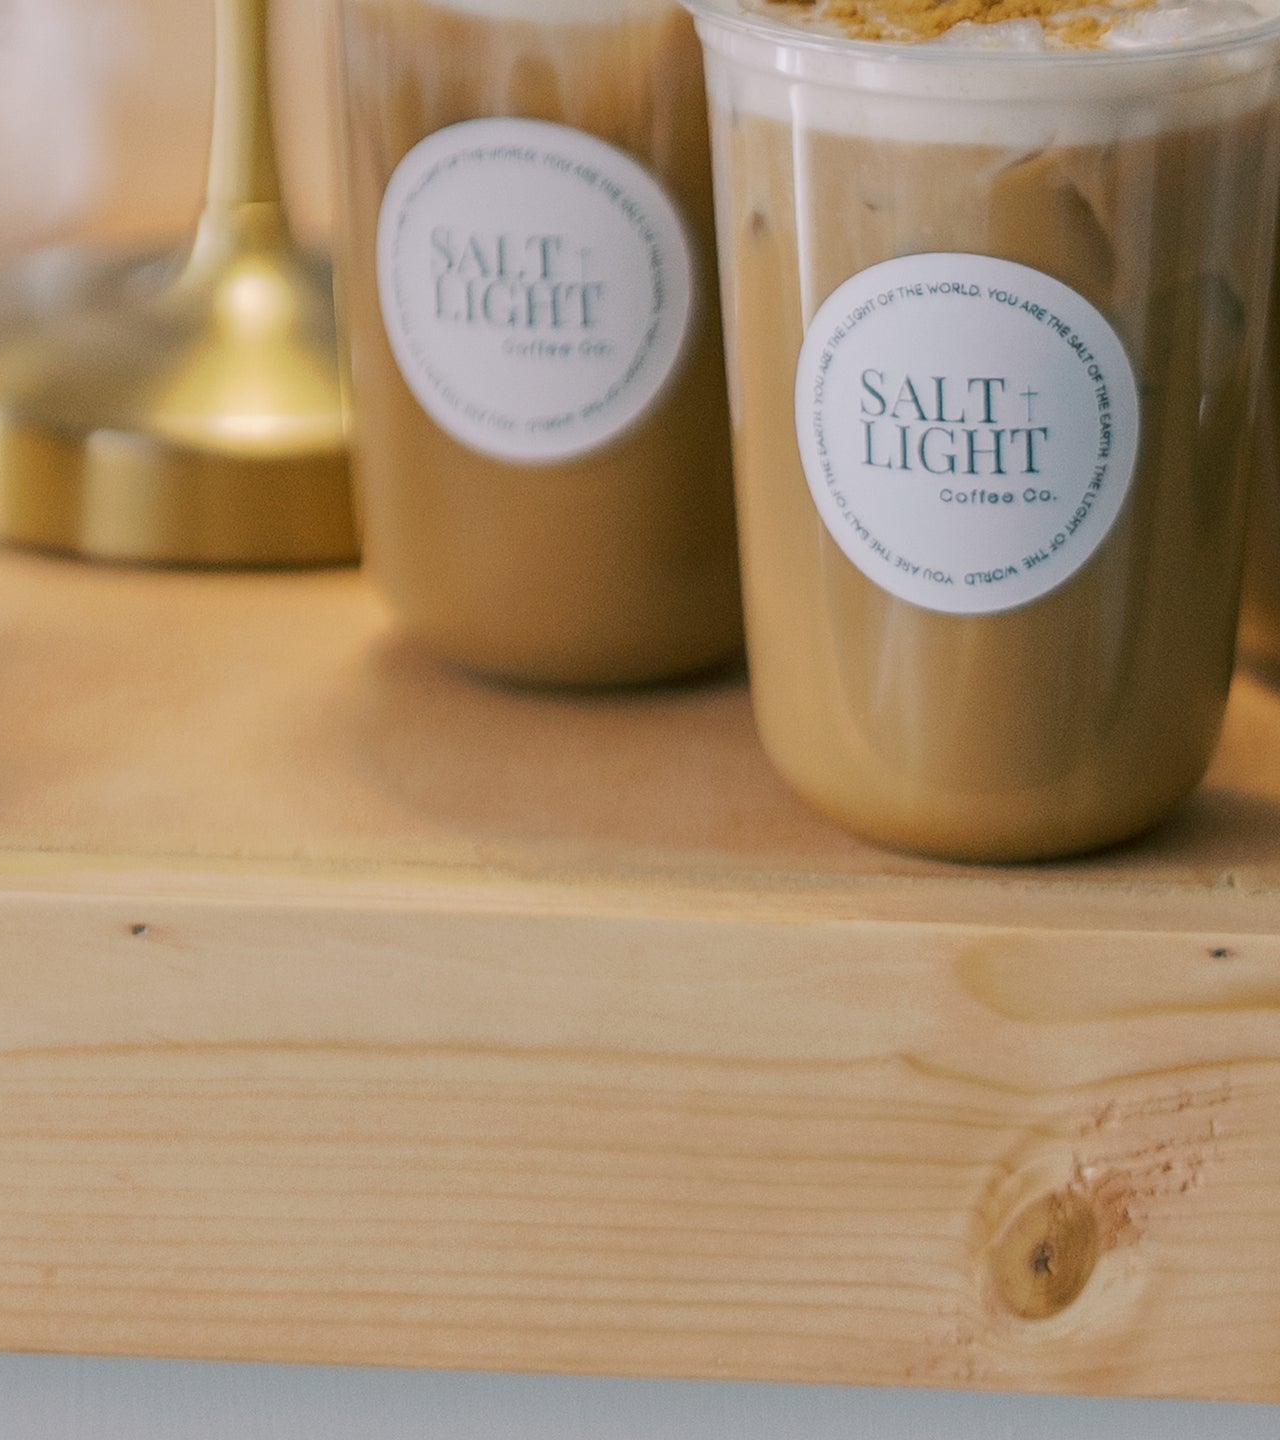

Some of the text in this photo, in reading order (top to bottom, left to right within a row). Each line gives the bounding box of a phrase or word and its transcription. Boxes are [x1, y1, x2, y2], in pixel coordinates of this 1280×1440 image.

[431, 224, 561, 280] SALT
[877, 289, 896, 306] OF
[896, 283, 924, 297] THE
[926, 281, 982, 298] WORLD.
[987, 287, 1019, 306] YOU
[433, 275, 604, 329] LIGHT
[1019, 300, 1048, 322] ARE
[842, 299, 876, 330] LIGHT
[1047, 313, 1072, 338] THE
[827, 326, 847, 350] THE
[1066, 334, 1096, 363] SALT
[1087, 364, 1104, 383] OF
[860, 368, 1005, 424] SALT
[1095, 384, 1111, 410] THE
[860, 420, 1048, 475] LIGHT
[1088, 463, 1107, 491] THE
[939, 487, 1058, 504] Coffee Co.
[1065, 491, 1096, 535] LIGHT
[870, 537, 894, 562] THE
[1049, 532, 1066, 552] OF
[895, 555, 920, 575] ARE
[1021, 548, 1050, 570] THE
[923, 568, 955, 586] YOU
